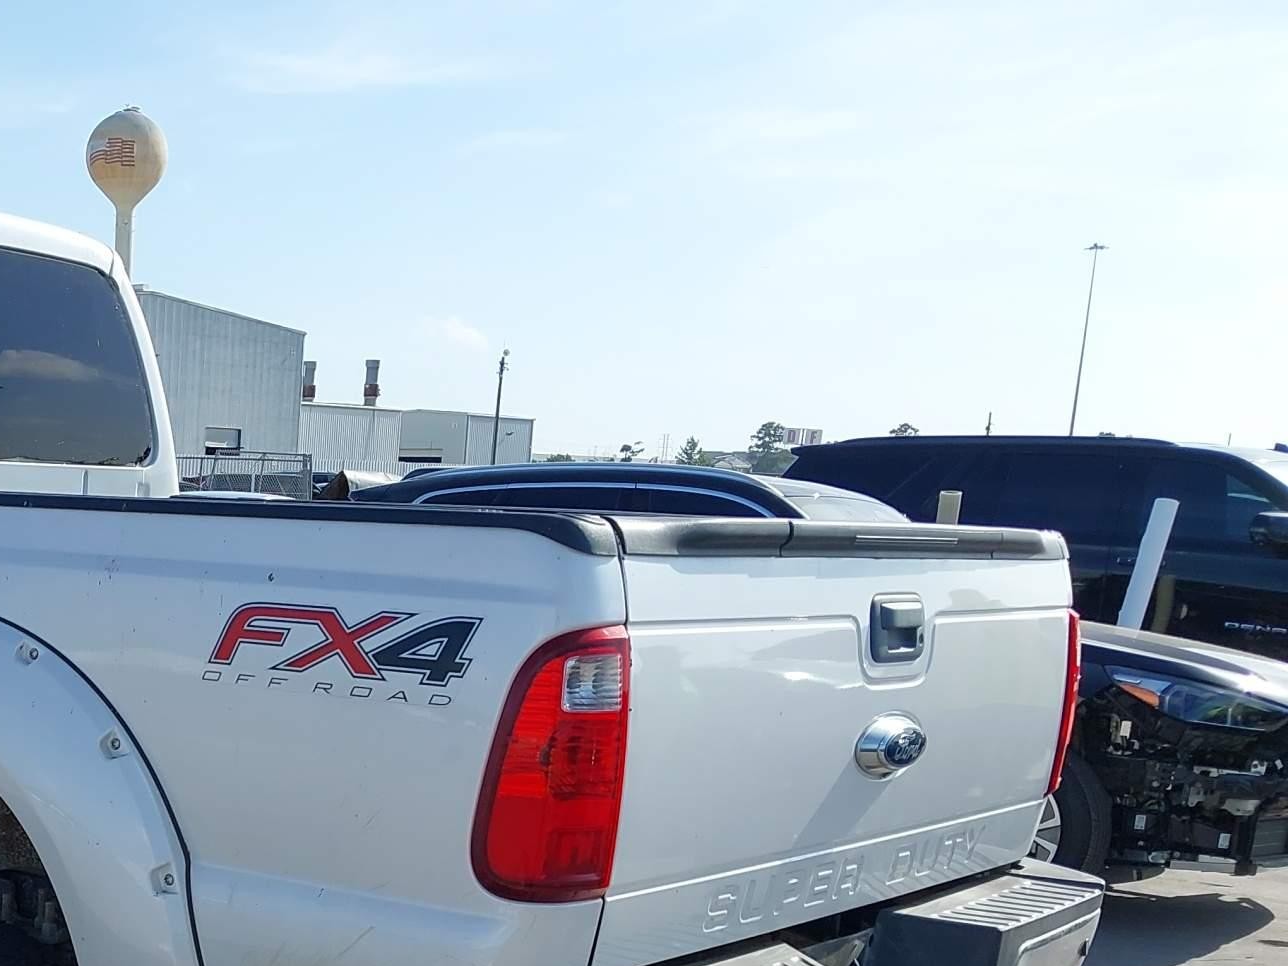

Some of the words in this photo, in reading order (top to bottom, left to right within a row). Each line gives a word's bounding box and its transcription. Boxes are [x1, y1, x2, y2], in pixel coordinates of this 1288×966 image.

[208, 602, 484, 687] FX4
[202, 670, 289, 689] OFF
[312, 682, 452, 706] ROAD
[893, 731, 923, 761] Ford
[702, 855, 864, 933] SUPER
[885, 824, 987, 886] DUTY
